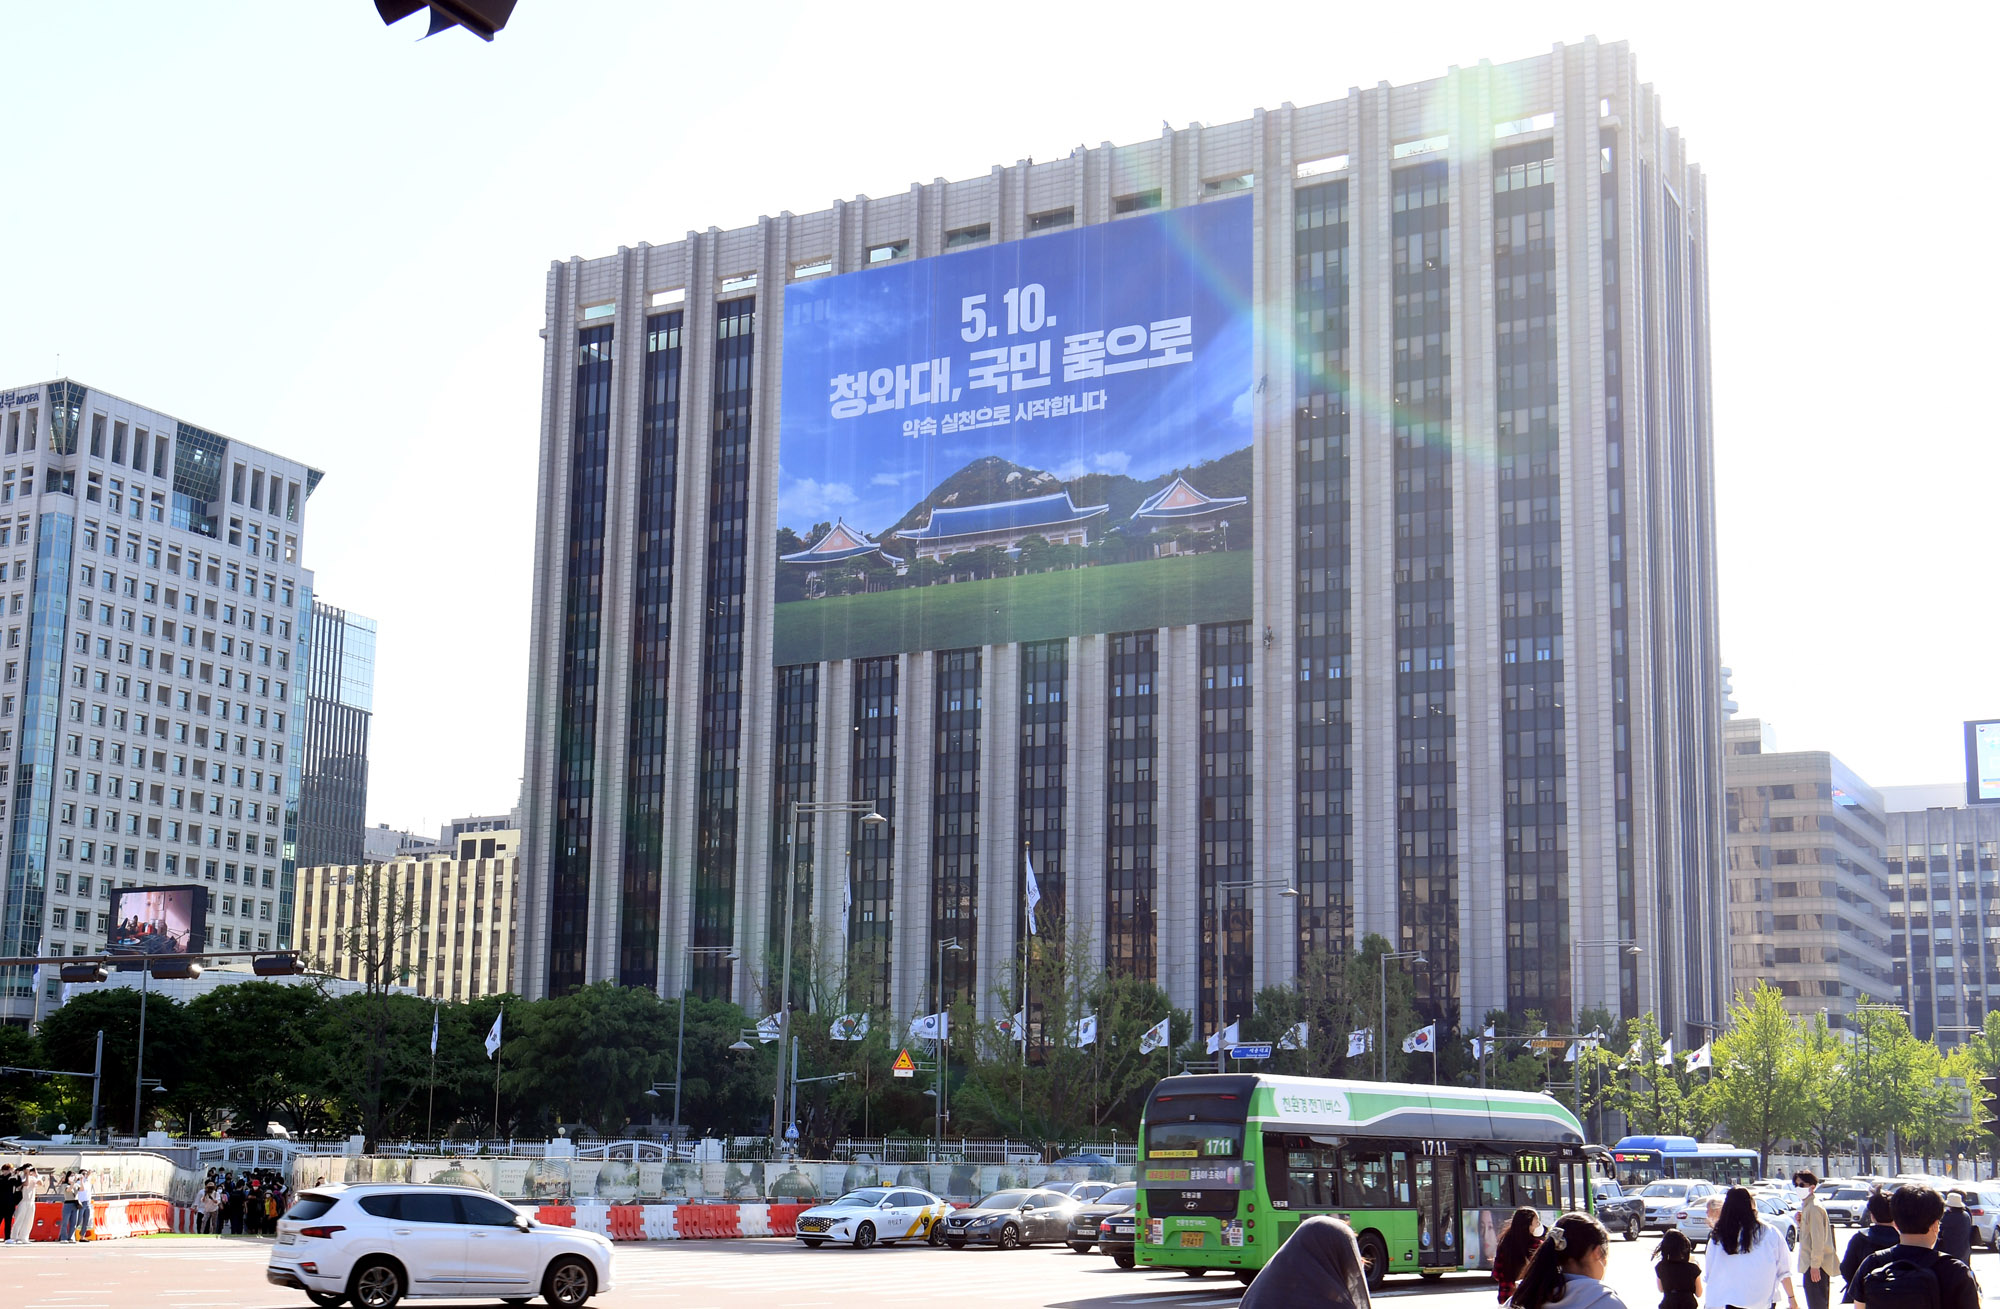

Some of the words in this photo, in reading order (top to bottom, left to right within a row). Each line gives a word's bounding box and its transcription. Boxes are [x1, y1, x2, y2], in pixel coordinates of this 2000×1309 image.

[829, 357, 962, 419] 청와대,
[969, 339, 1051, 394] 국민
[1062, 315, 1193, 383] 품으로
[16, 392, 39, 404] MOFA
[902, 414, 938, 438] 약속
[941, 403, 1010, 434] 실천으로
[1015, 389, 1107, 423] 시작합니다
[1206, 1139, 1231, 1154] 1711
[1421, 1140, 1447, 1156] 1711
[1519, 1156, 1547, 1172] 1711
